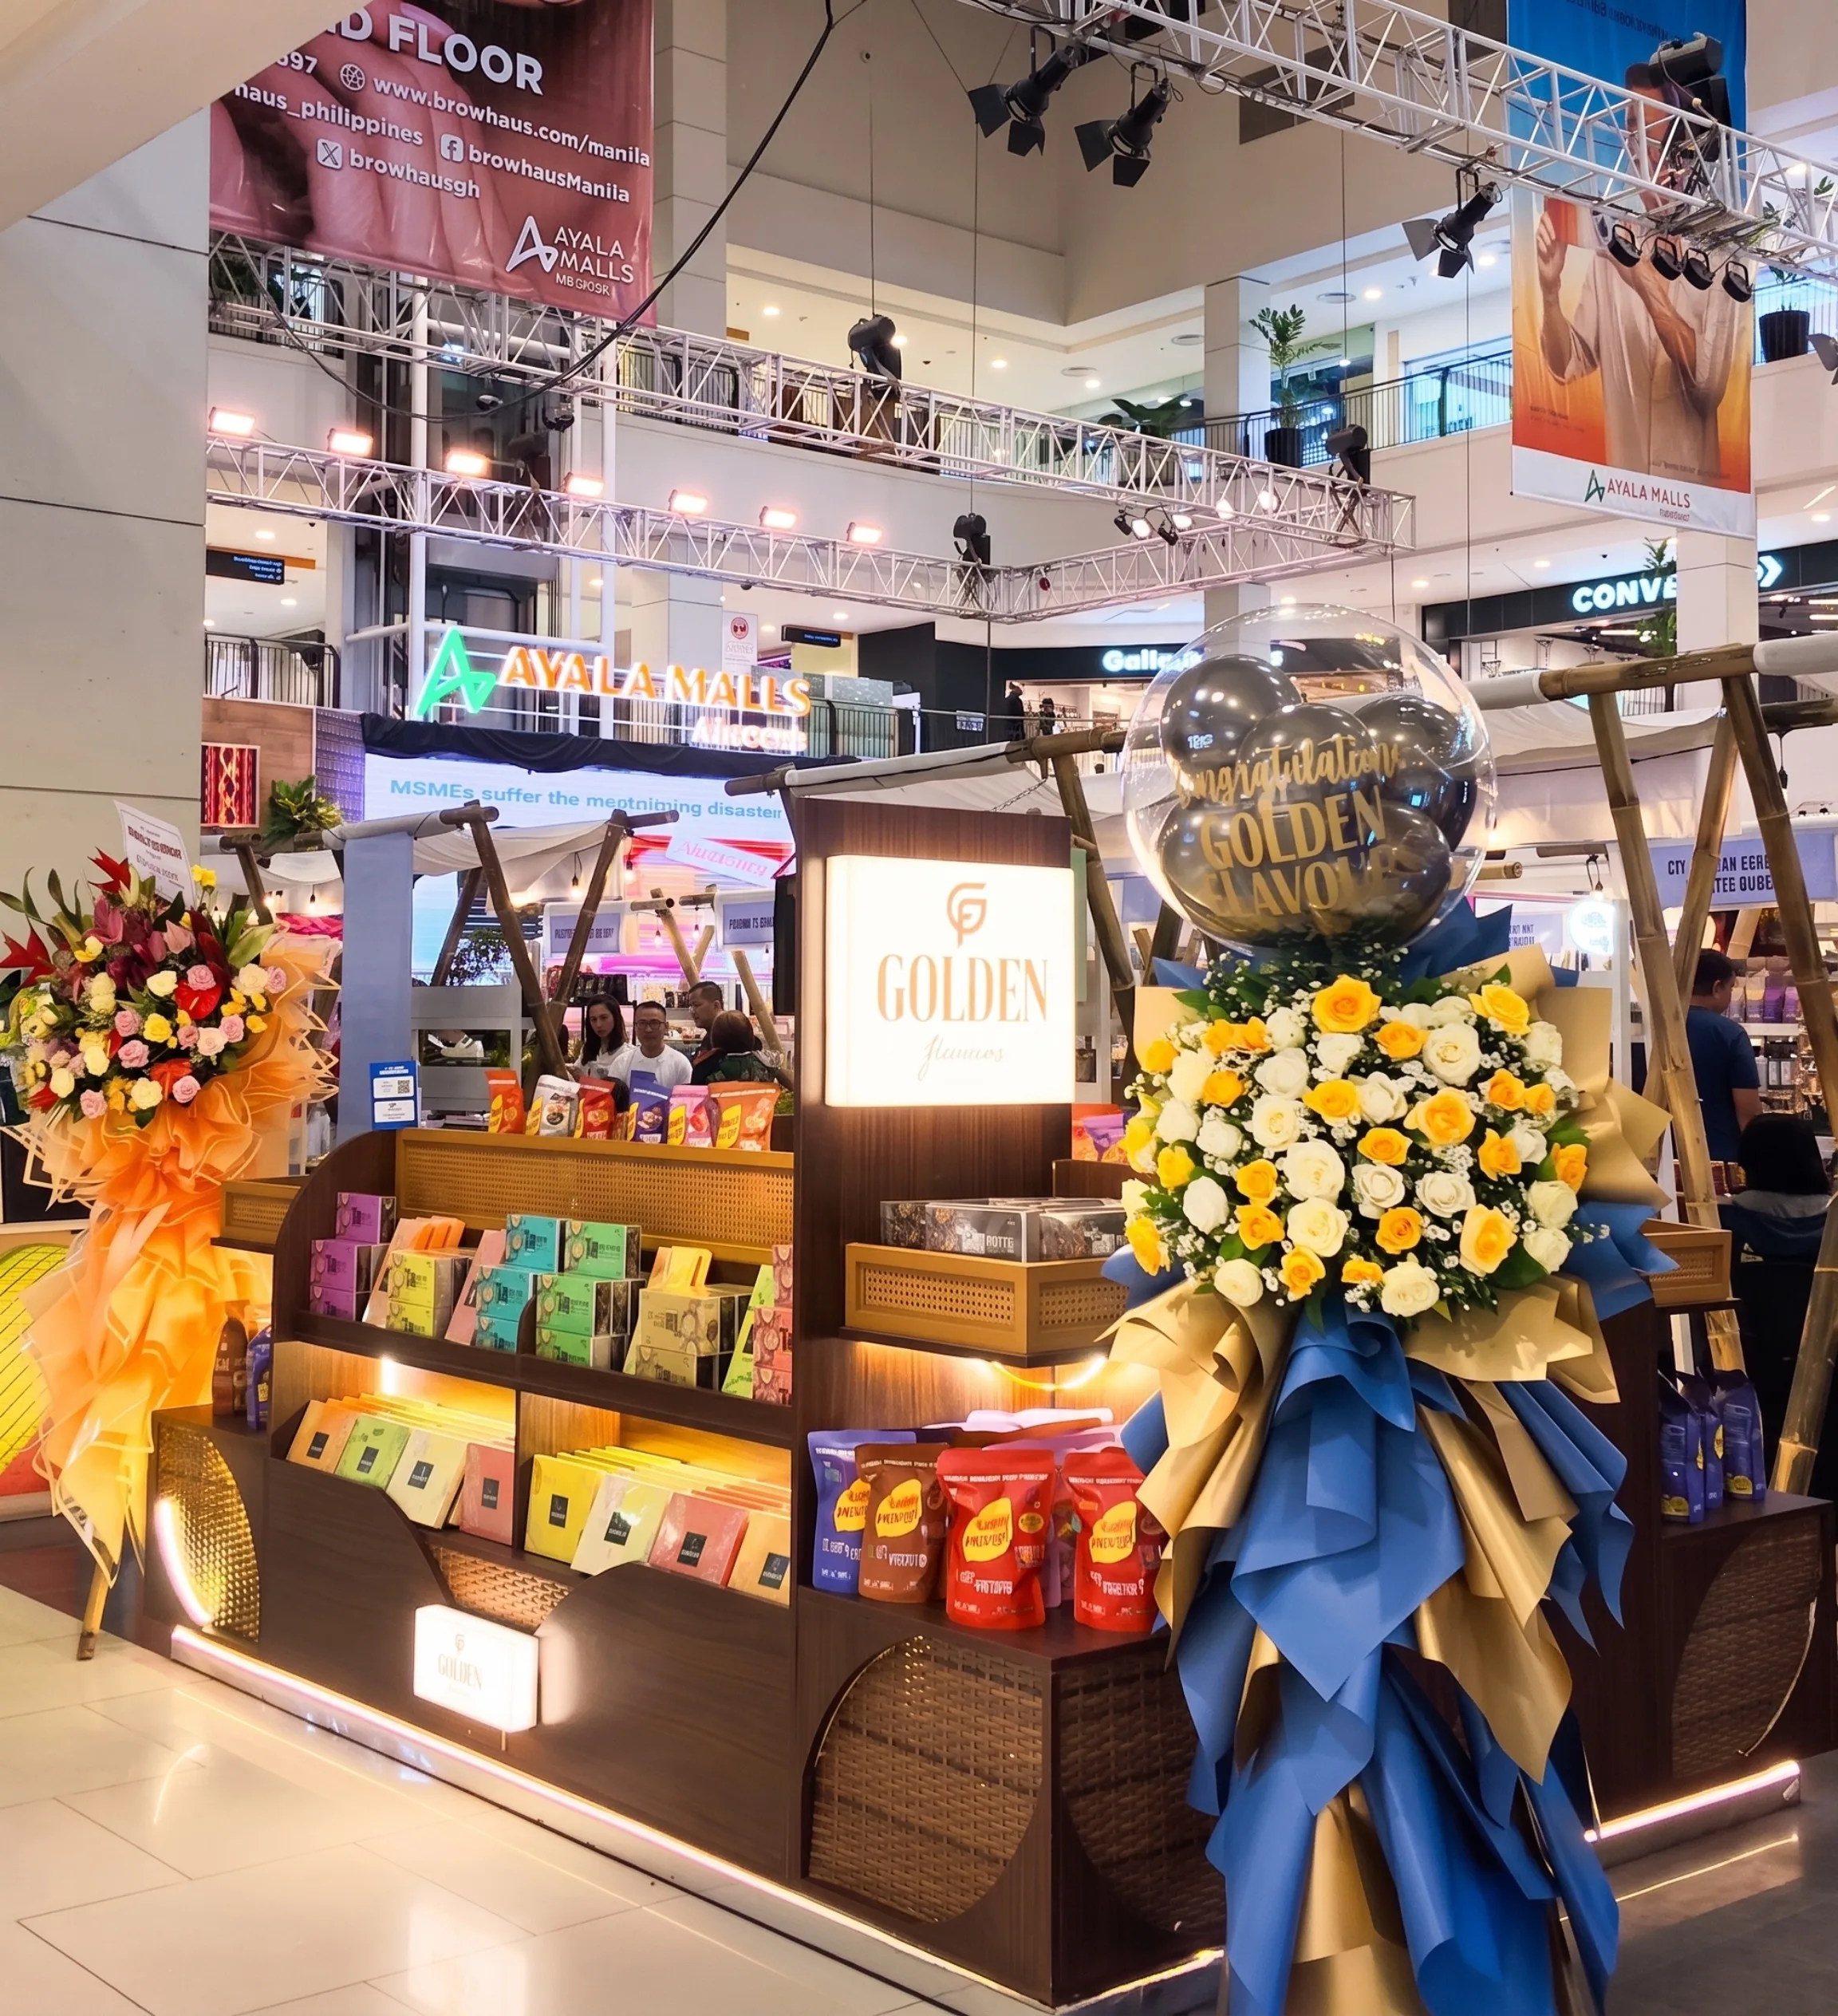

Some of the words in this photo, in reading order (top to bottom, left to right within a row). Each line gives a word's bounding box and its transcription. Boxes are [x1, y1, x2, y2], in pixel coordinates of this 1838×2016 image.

[326, 7, 373, 41] D
[389, 13, 544, 96] FLOOR
[373, 76, 650, 168] www.browhaus.com/manila
[349, 148, 481, 199] browhausgh
[554, 226, 625, 260] AYALA
[559, 253, 635, 284] MALLS
[1607, 478, 1648, 501] AYALA
[1651, 486, 1691, 509] MALLS
[1572, 572, 1677, 613] CONVE
[498, 645, 657, 700] AYALA
[664, 664, 812, 718] MALLS
[390, 779, 474, 799] MSMEs
[481, 787, 542, 803] suffer
[548, 791, 580, 806] the
[1200, 784, 1386, 870] GOLDEN
[877, 953, 1048, 1023] GOLDEN
[437, 1653, 483, 1691] GOLDEN
